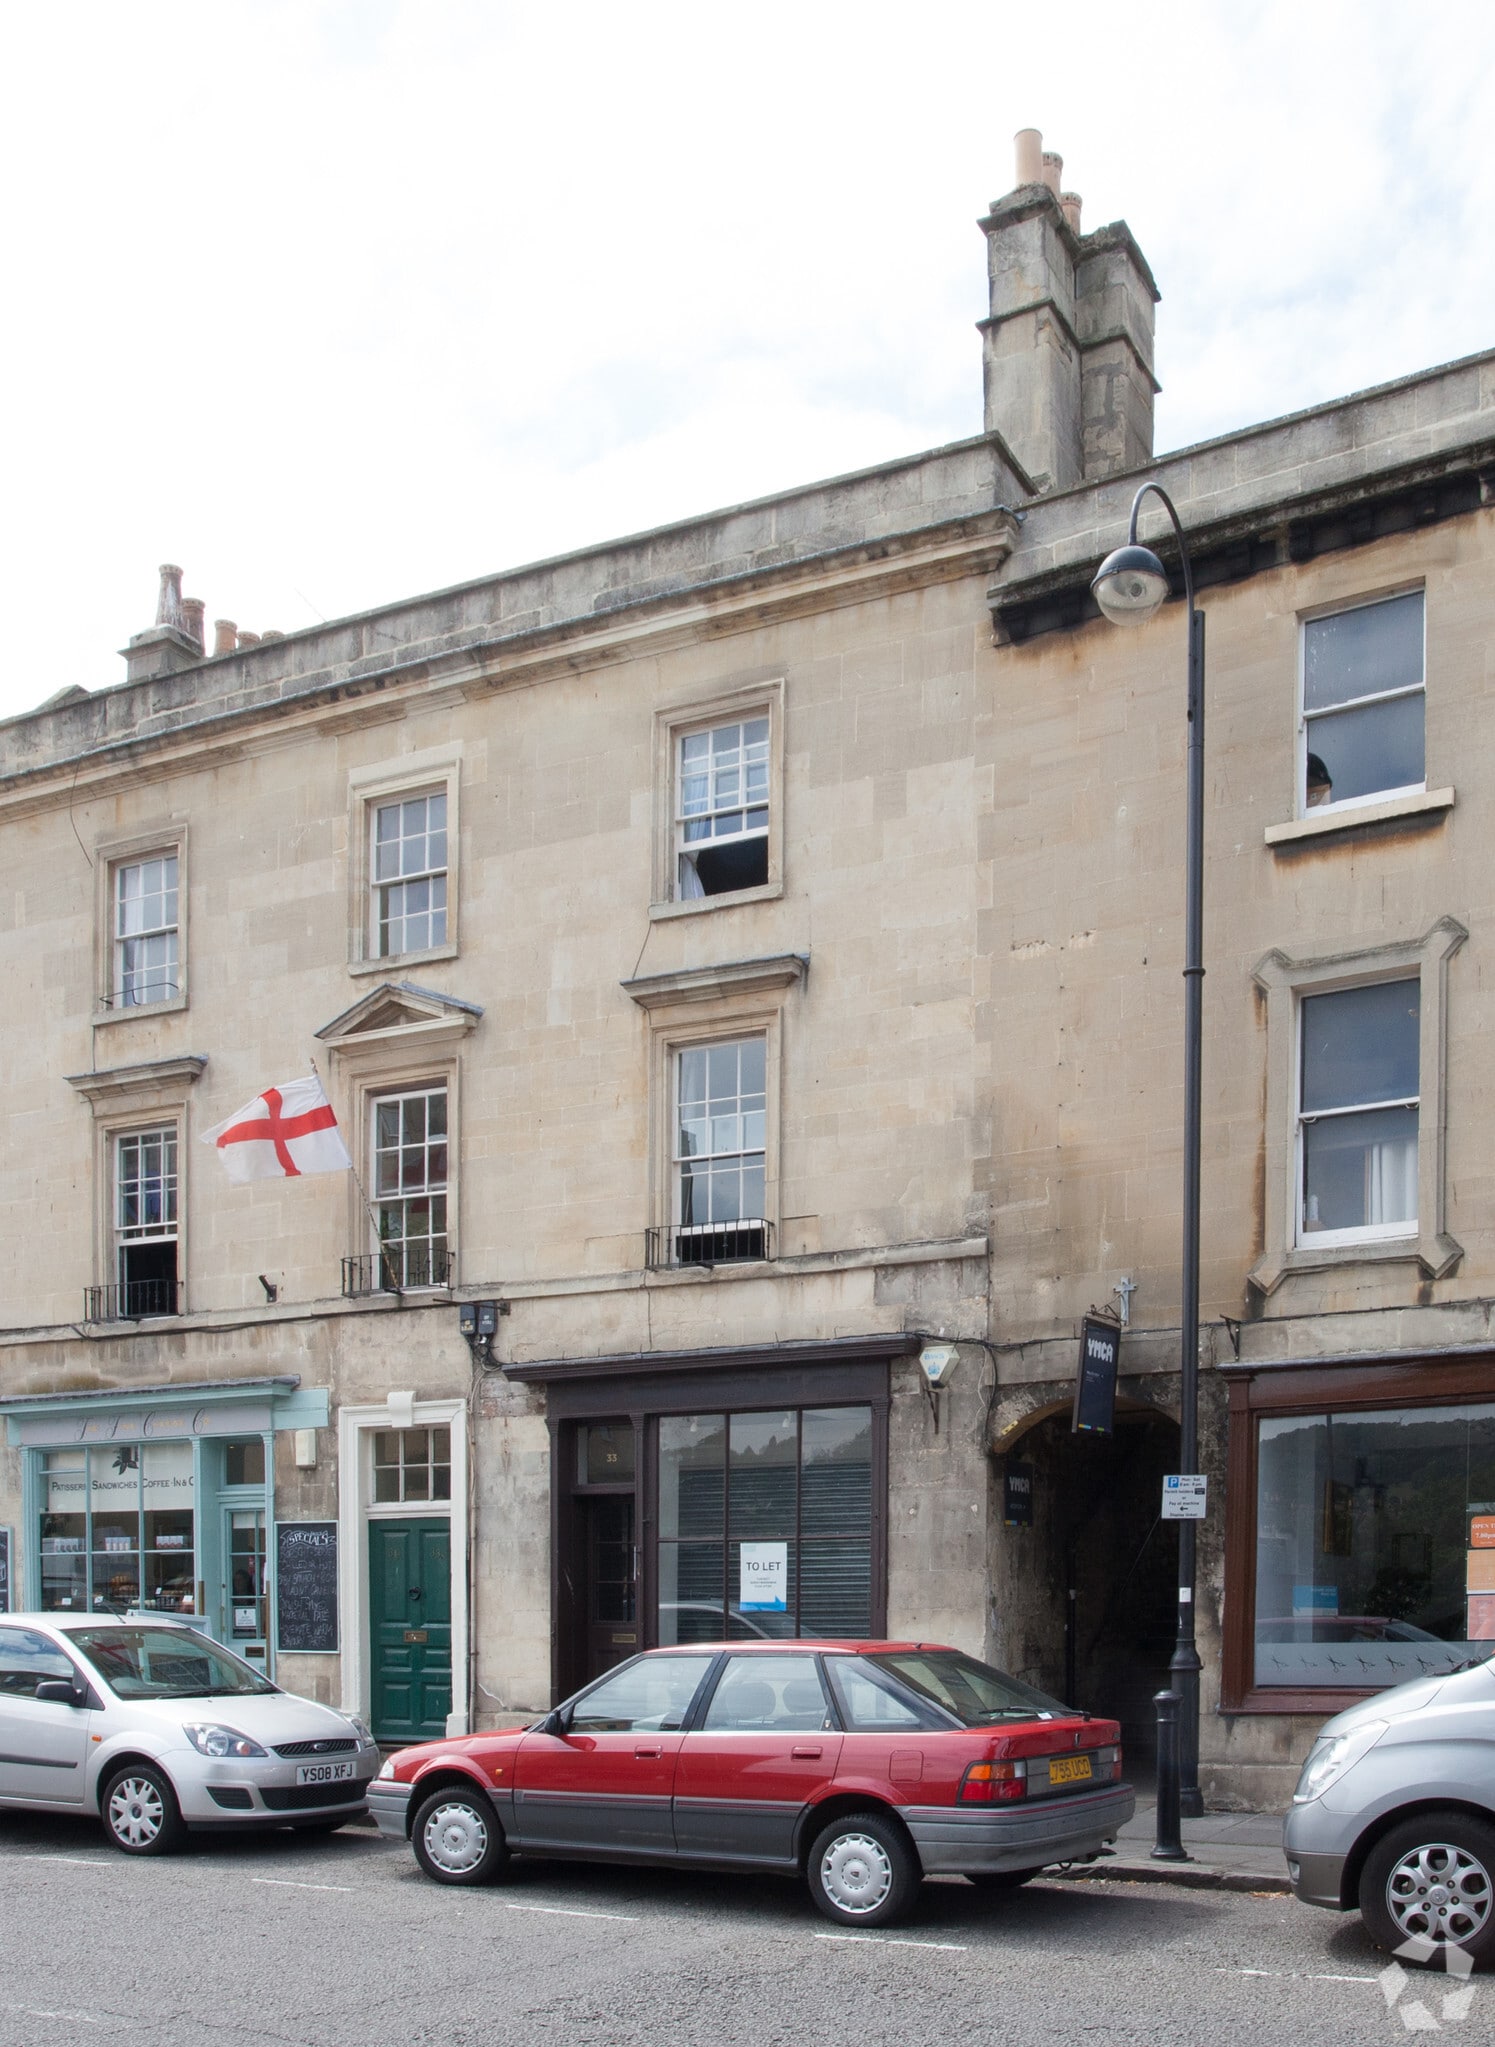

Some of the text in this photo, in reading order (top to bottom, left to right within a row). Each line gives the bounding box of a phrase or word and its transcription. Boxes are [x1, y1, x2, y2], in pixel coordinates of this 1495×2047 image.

[1087, 1338, 1114, 1363] YMCA
[606, 1453, 618, 1463] 33
[91, 1480, 138, 1490] SANDWICHES
[1009, 1476, 1030, 1494] YMCA
[746, 1561, 782, 1571] TO LET
[334, 1763, 353, 1779] XFJ
[1050, 1762, 1072, 1781] 755
